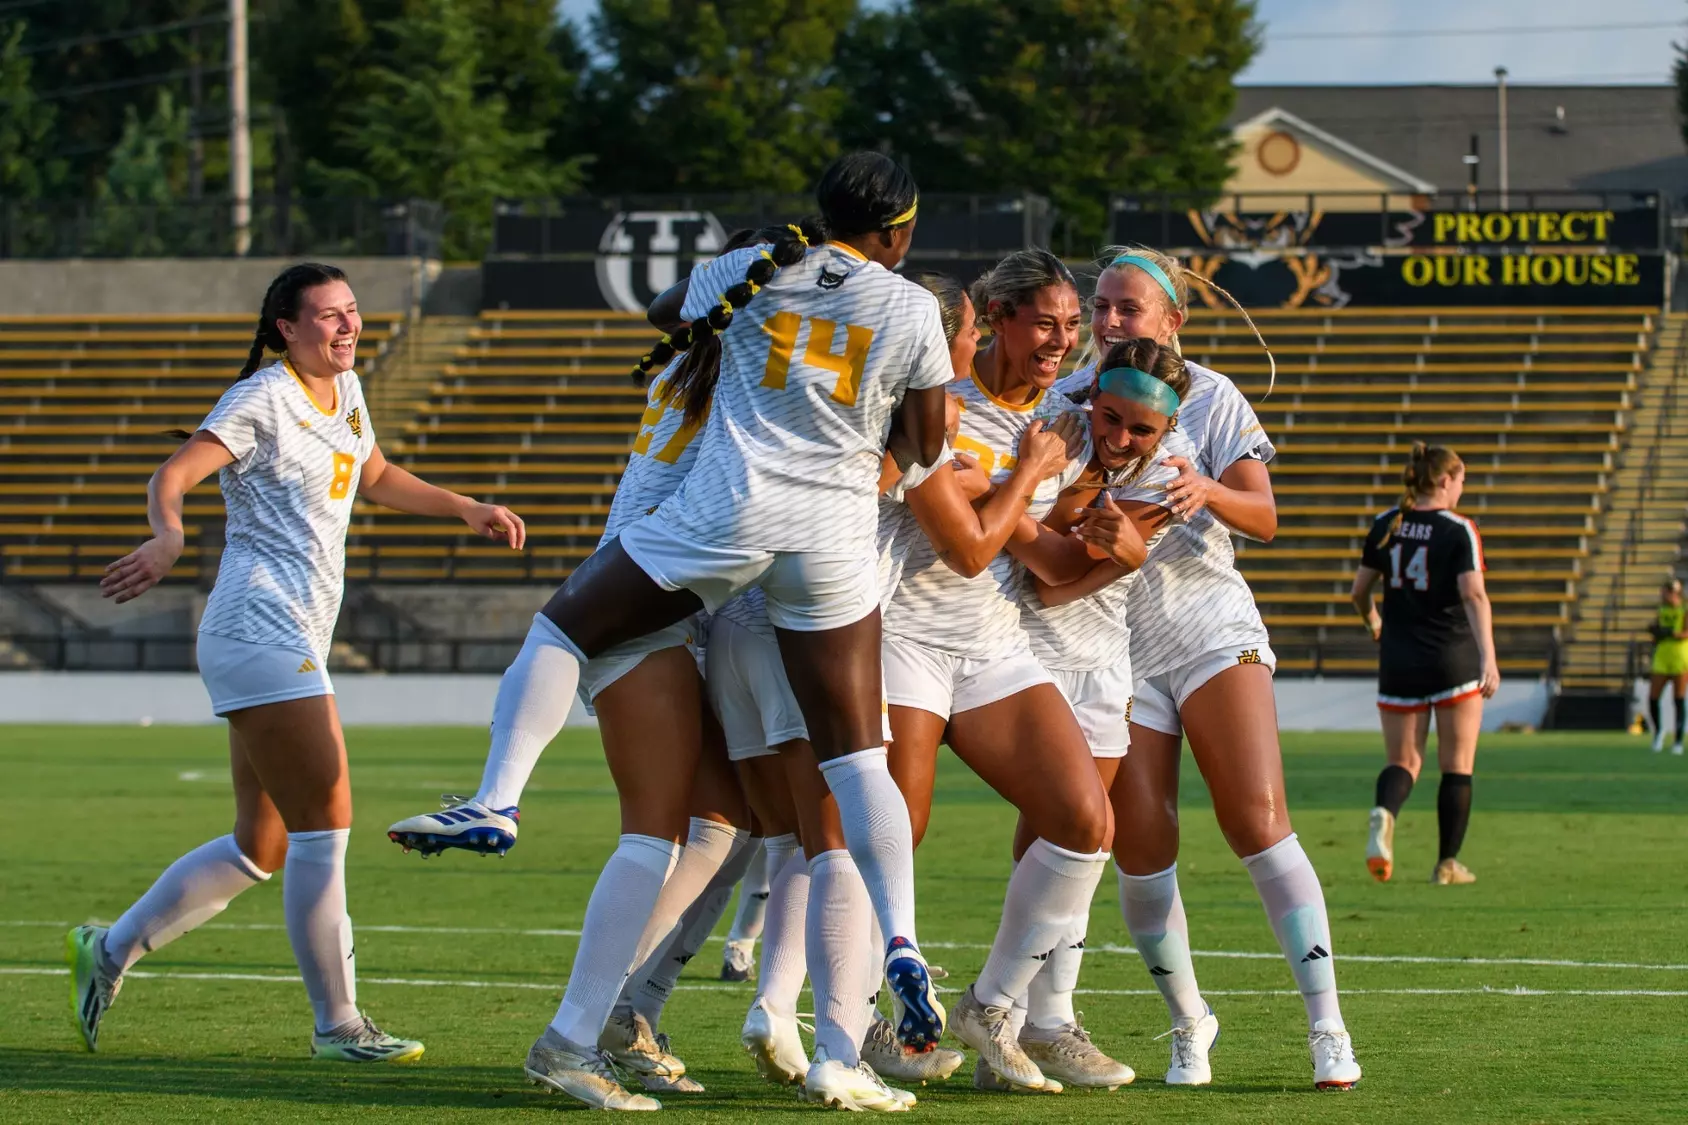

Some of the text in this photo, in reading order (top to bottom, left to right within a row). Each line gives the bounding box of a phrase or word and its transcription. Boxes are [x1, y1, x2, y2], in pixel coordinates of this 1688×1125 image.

[1433, 211, 1614, 242] PROTECT
[1402, 254, 1641, 287] OUR HOUSE
[759, 311, 874, 407] 14
[329, 451, 356, 499] 8
[1392, 521, 1433, 540] EARS
[1390, 543, 1429, 591] 14
